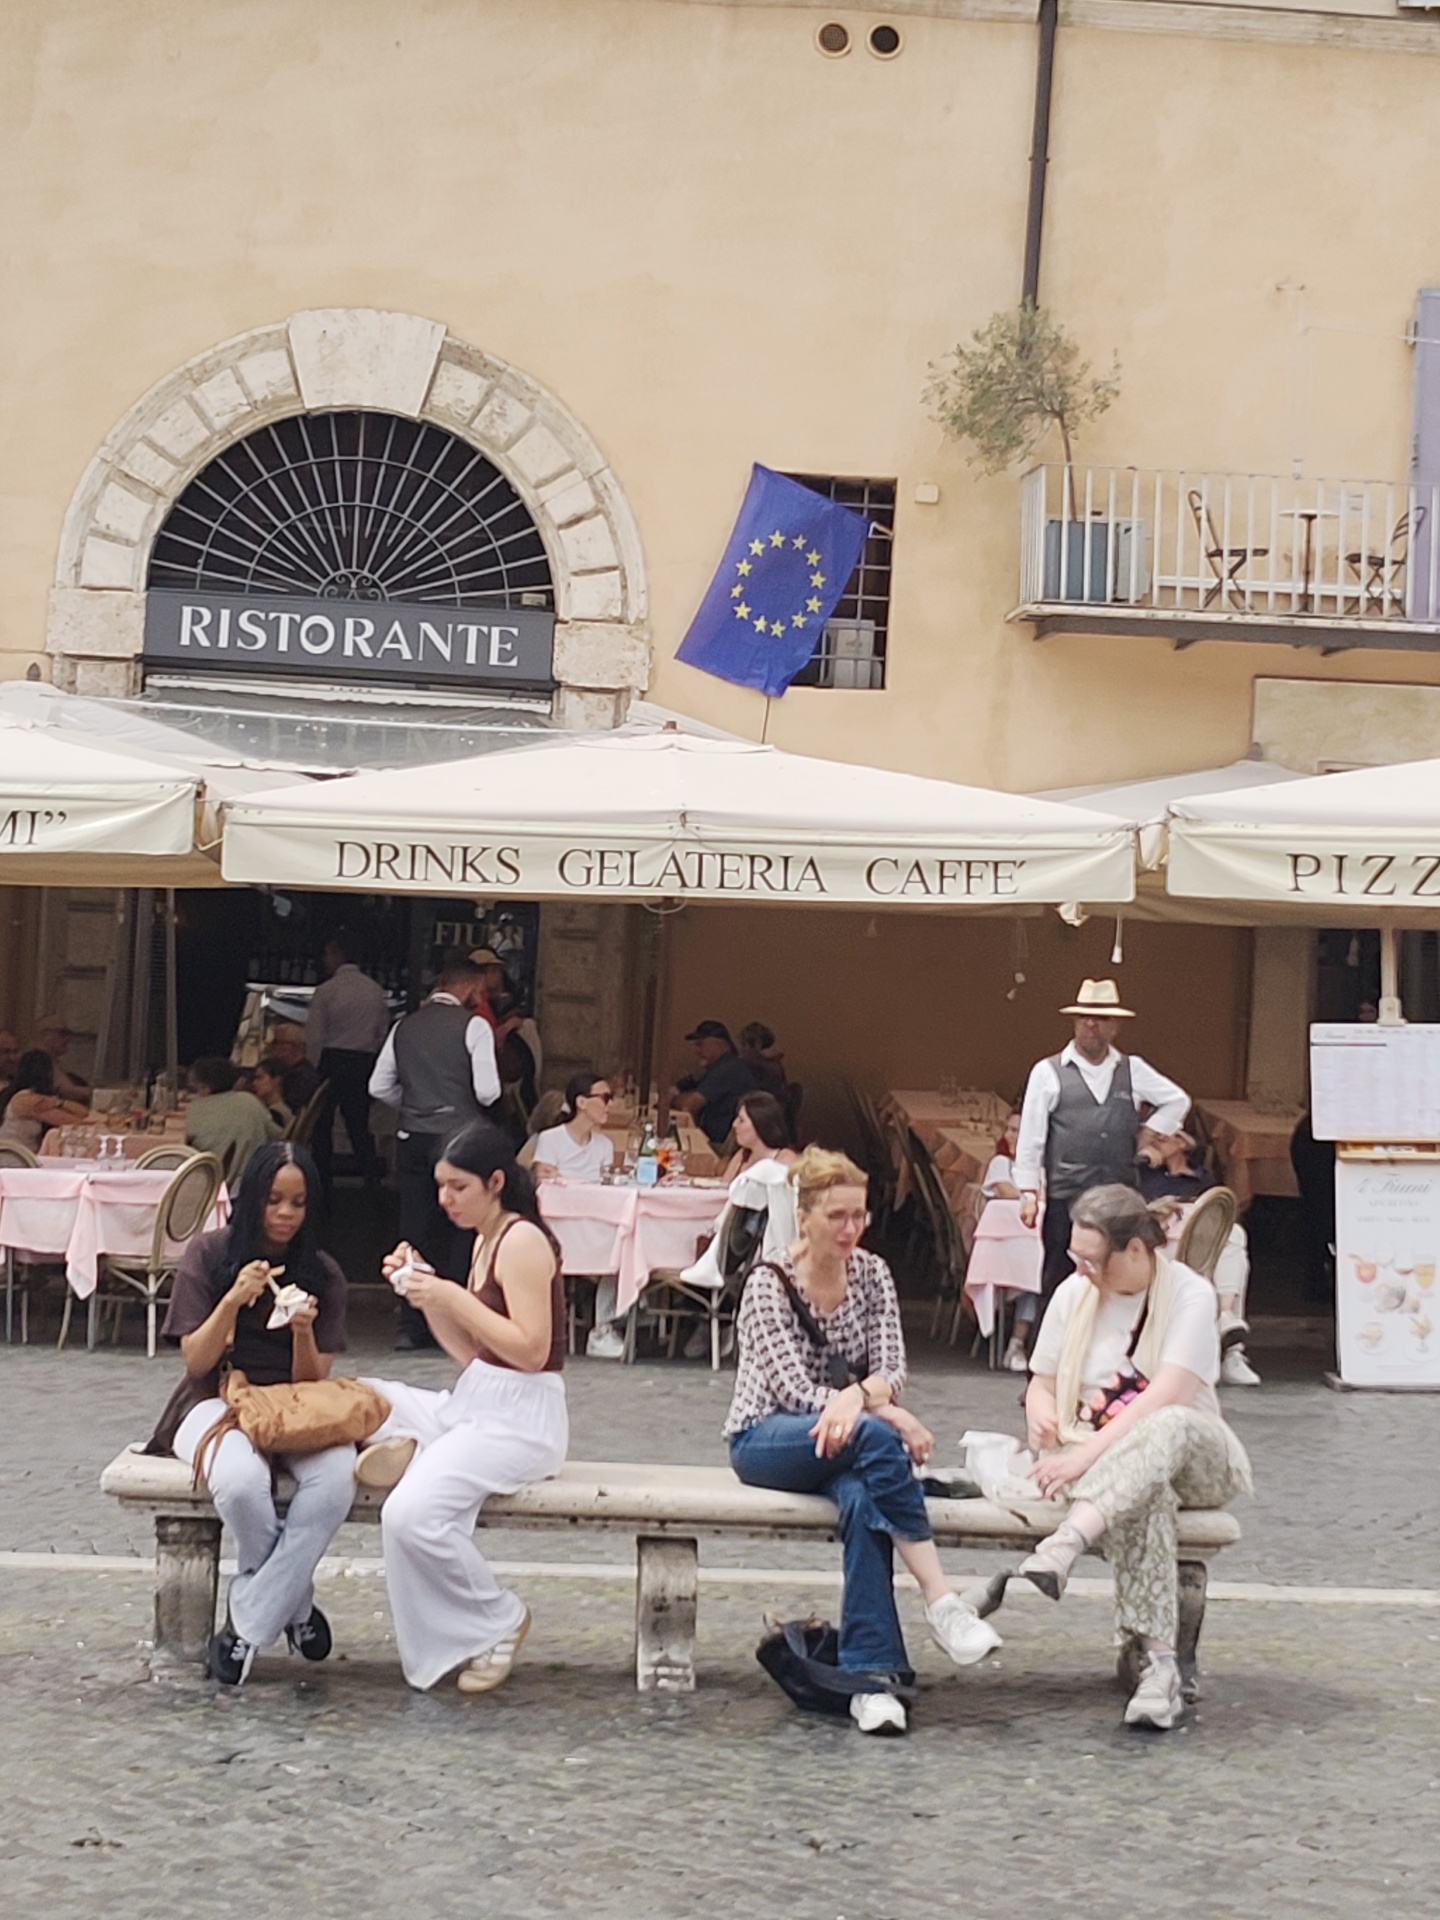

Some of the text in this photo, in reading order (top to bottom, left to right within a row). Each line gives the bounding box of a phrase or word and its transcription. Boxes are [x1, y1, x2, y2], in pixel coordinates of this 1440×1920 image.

[179, 605, 519, 667] RISTORANTE
[335, 841, 521, 885] DRINKS
[559, 849, 828, 893] GELATERIA
[1286, 853, 1440, 896] PIZZ
